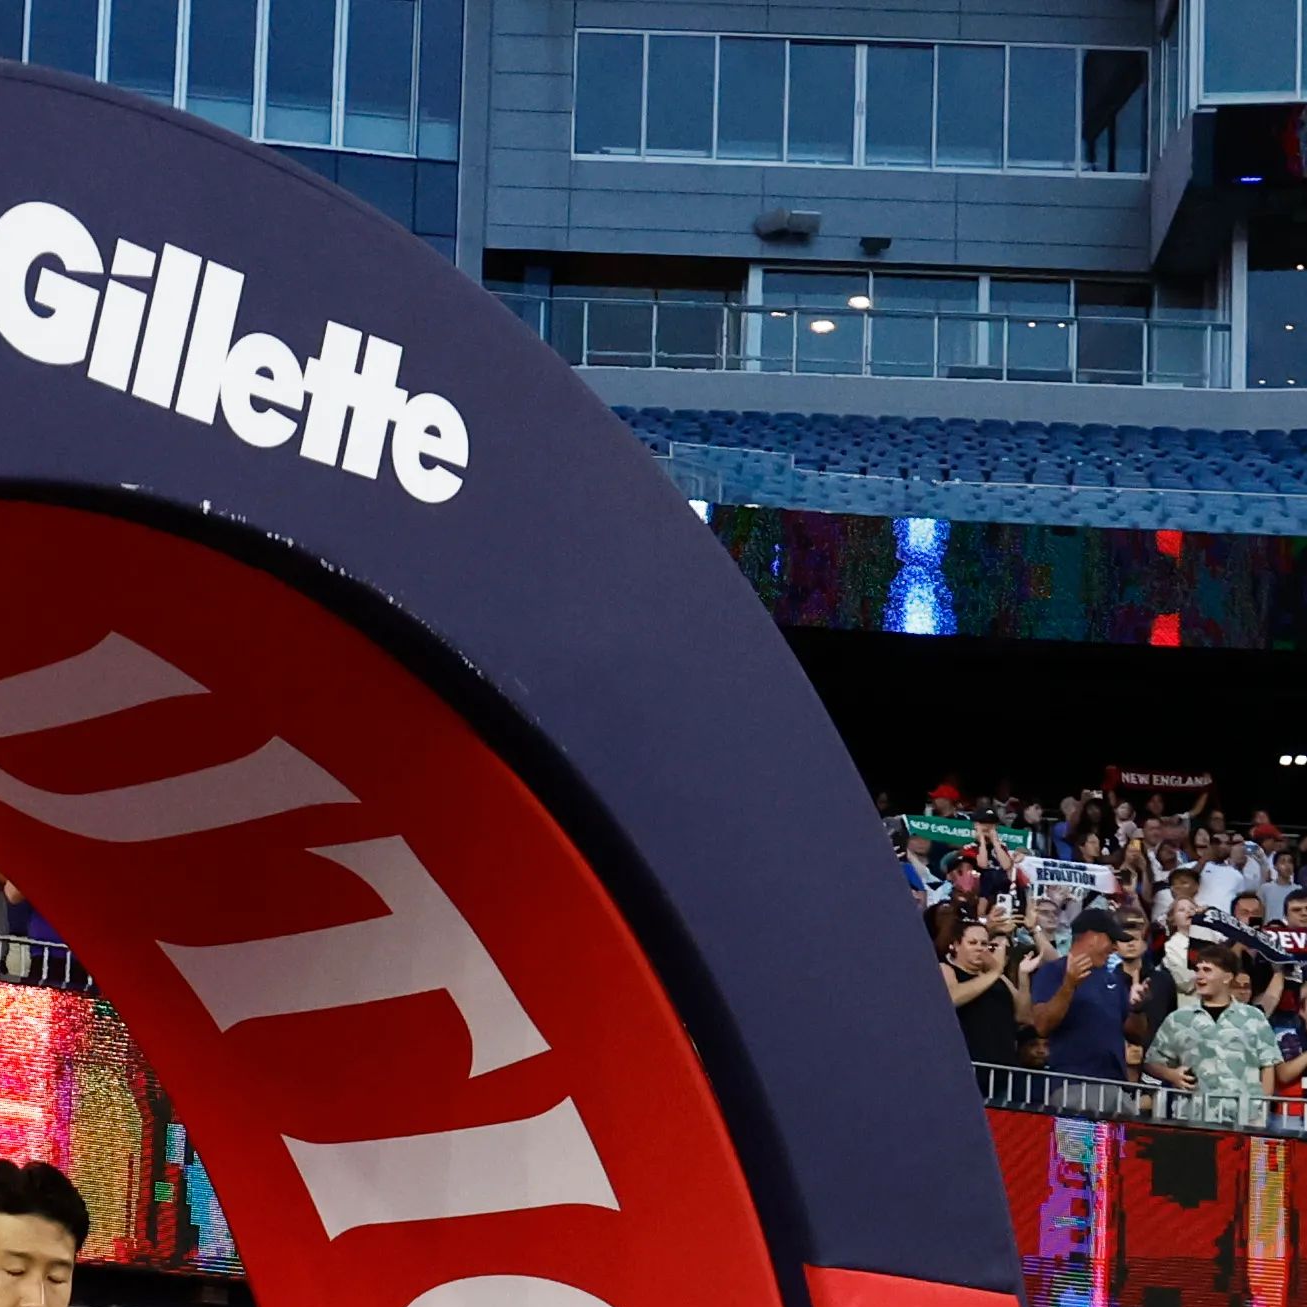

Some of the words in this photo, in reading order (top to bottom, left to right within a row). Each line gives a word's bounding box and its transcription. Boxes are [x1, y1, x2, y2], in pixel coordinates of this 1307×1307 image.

[1121, 772, 1150, 784] NEW
[1152, 774, 1213, 787] ENGLAND
[1036, 868, 1096, 886] REVOLUTION
